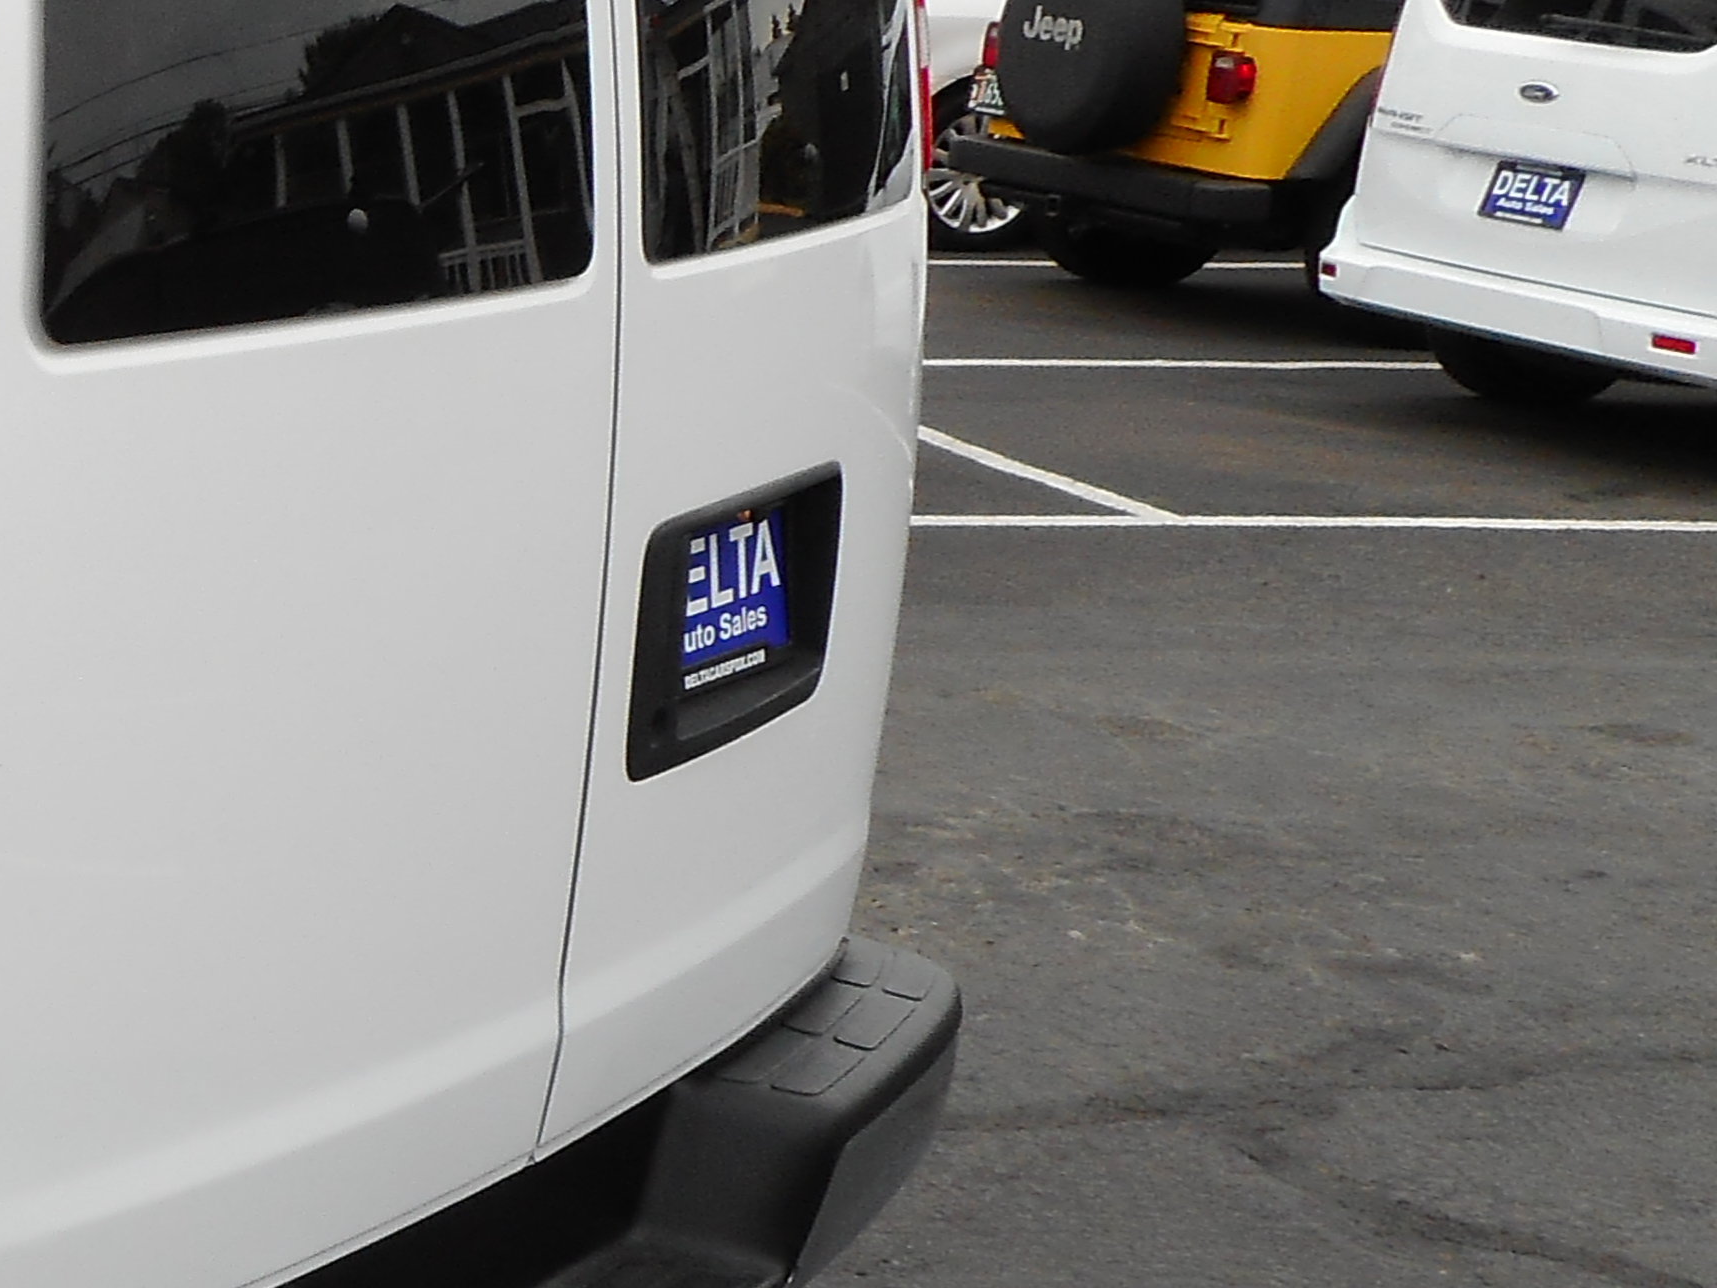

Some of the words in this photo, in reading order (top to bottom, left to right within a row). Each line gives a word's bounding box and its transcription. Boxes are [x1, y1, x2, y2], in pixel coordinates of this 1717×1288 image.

[1023, 4, 1084, 50] Jeep
[1492, 169, 1572, 207] DELTA
[719, 605, 769, 642] Sales
